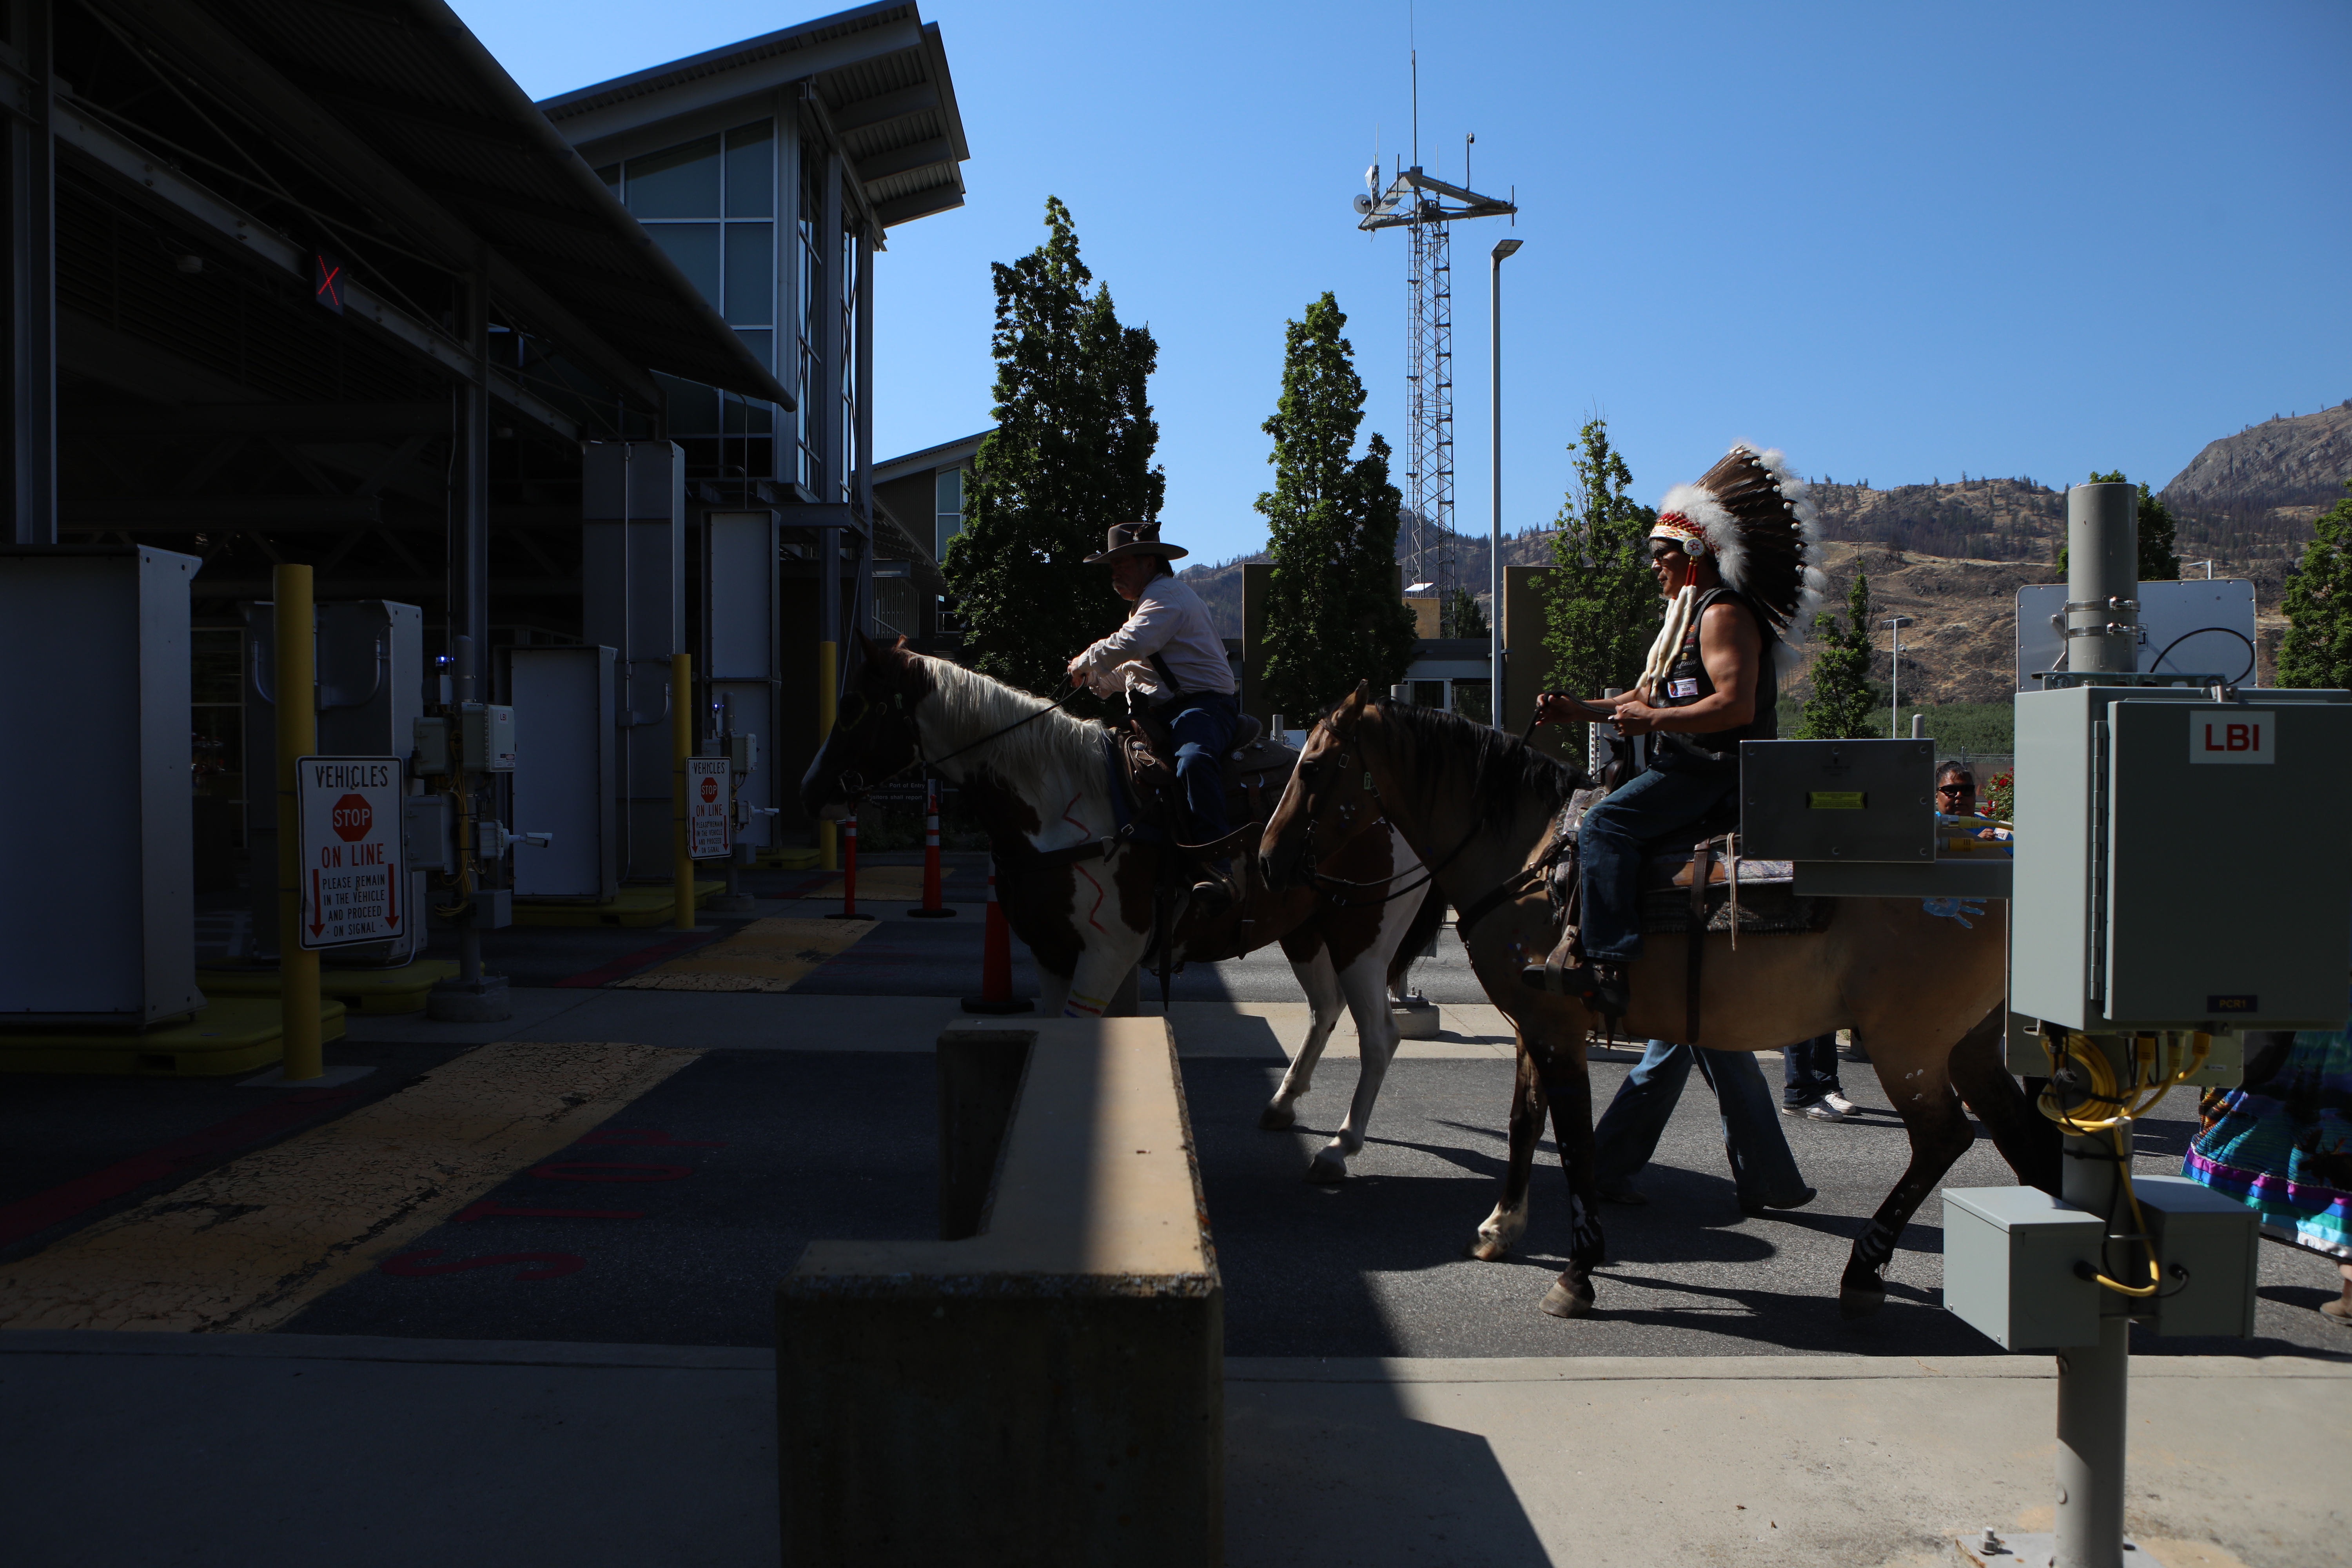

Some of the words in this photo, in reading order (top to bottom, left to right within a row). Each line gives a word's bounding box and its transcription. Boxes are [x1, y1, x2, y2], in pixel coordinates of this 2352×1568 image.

[2206, 724, 2259, 751] LBI
[694, 762, 724, 774] VEHICLES
[316, 766, 387, 788] VEHICLES
[702, 785, 717, 795] STOP
[334, 809, 370, 827] STOP
[697, 805, 704, 817] ON
[709, 804, 722, 816] LINE
[322, 846, 341, 868] ON
[352, 844, 384, 866] LINE
[323, 877, 351, 889] PLEASE
[356, 874, 385, 887] REMAIN
[324, 895, 331, 906] IN
[336, 893, 349, 904] THE
[353, 890, 385, 903] VEHICLE
[328, 909, 343, 921] AND
[348, 906, 381, 919] PROCEED
[334, 925, 343, 936] ON
[348, 922, 376, 935] SIGNAL
[381, 1129, 730, 1281] STOP
